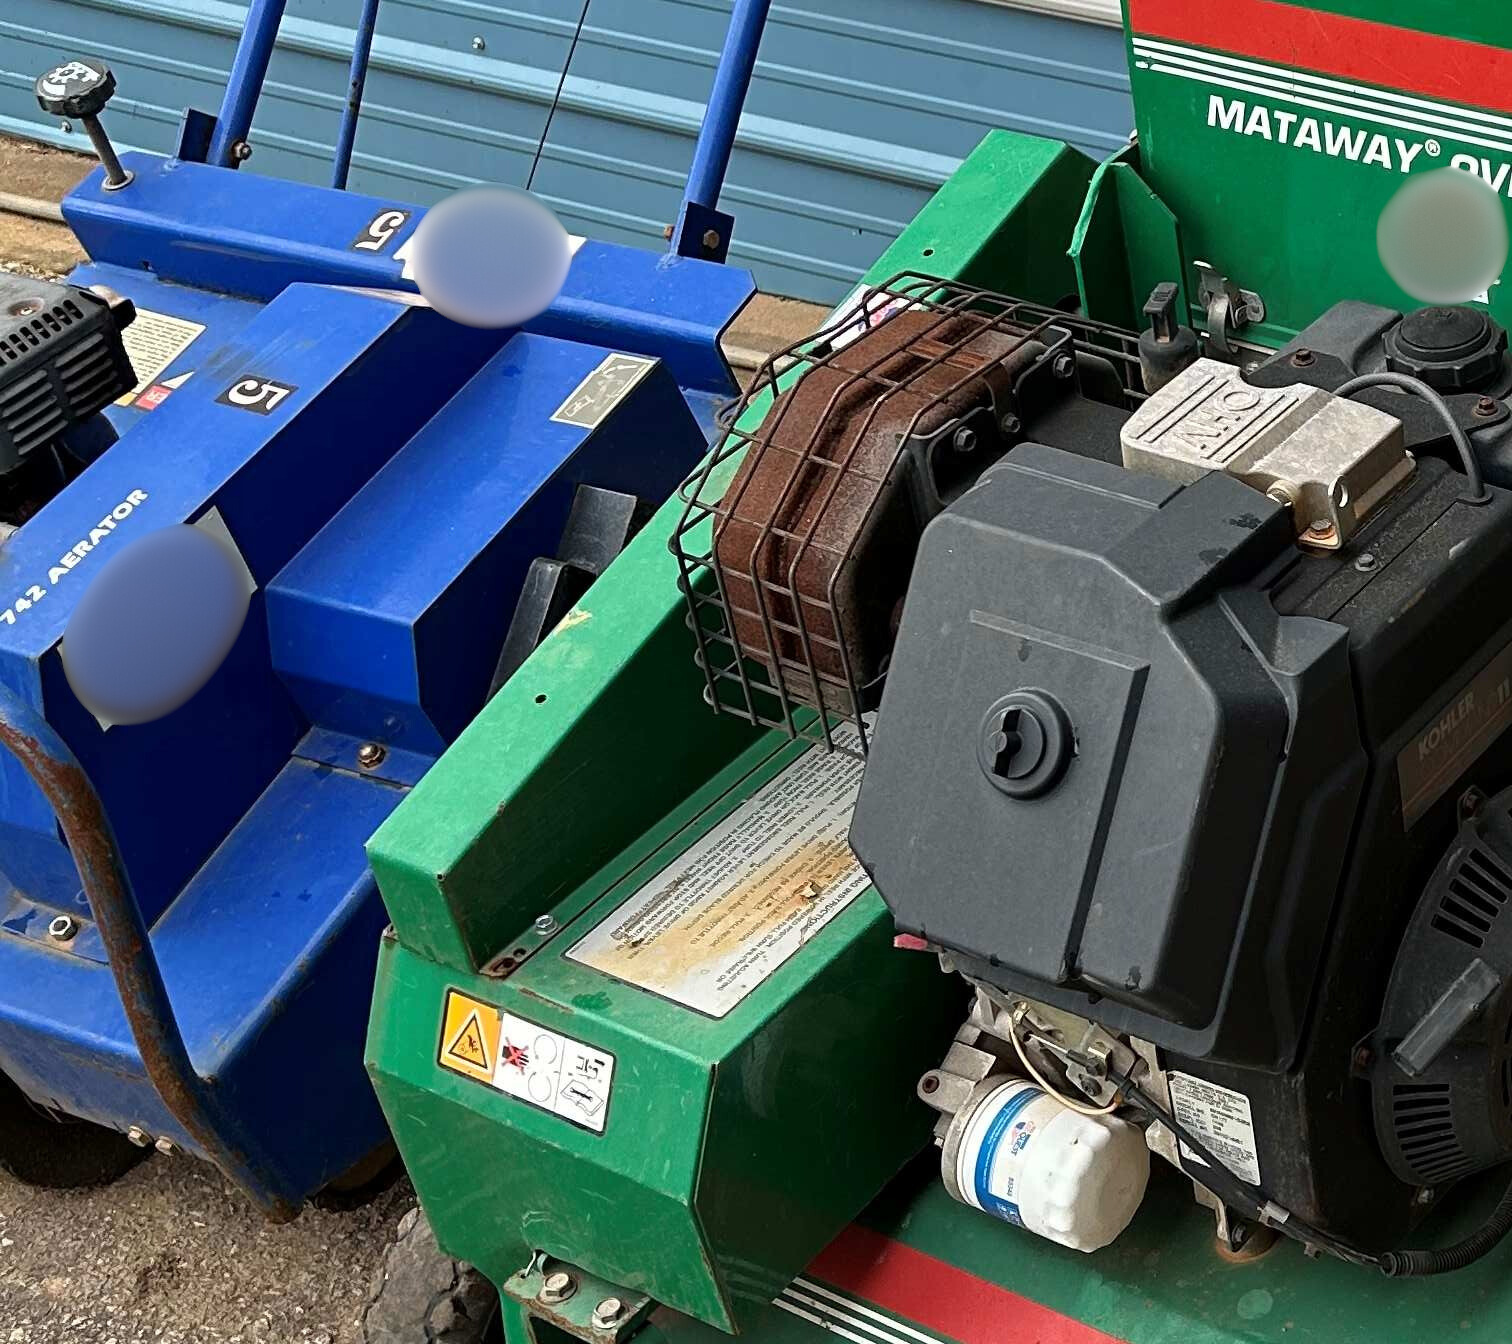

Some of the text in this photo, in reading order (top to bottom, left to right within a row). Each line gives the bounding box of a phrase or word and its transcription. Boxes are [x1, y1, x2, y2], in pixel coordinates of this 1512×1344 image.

[354, 211, 405, 251] 5
[228, 376, 284, 411] 5
[0, 488, 148, 626] 742 AERATOR
[1417, 691, 1475, 760] KOHLER
